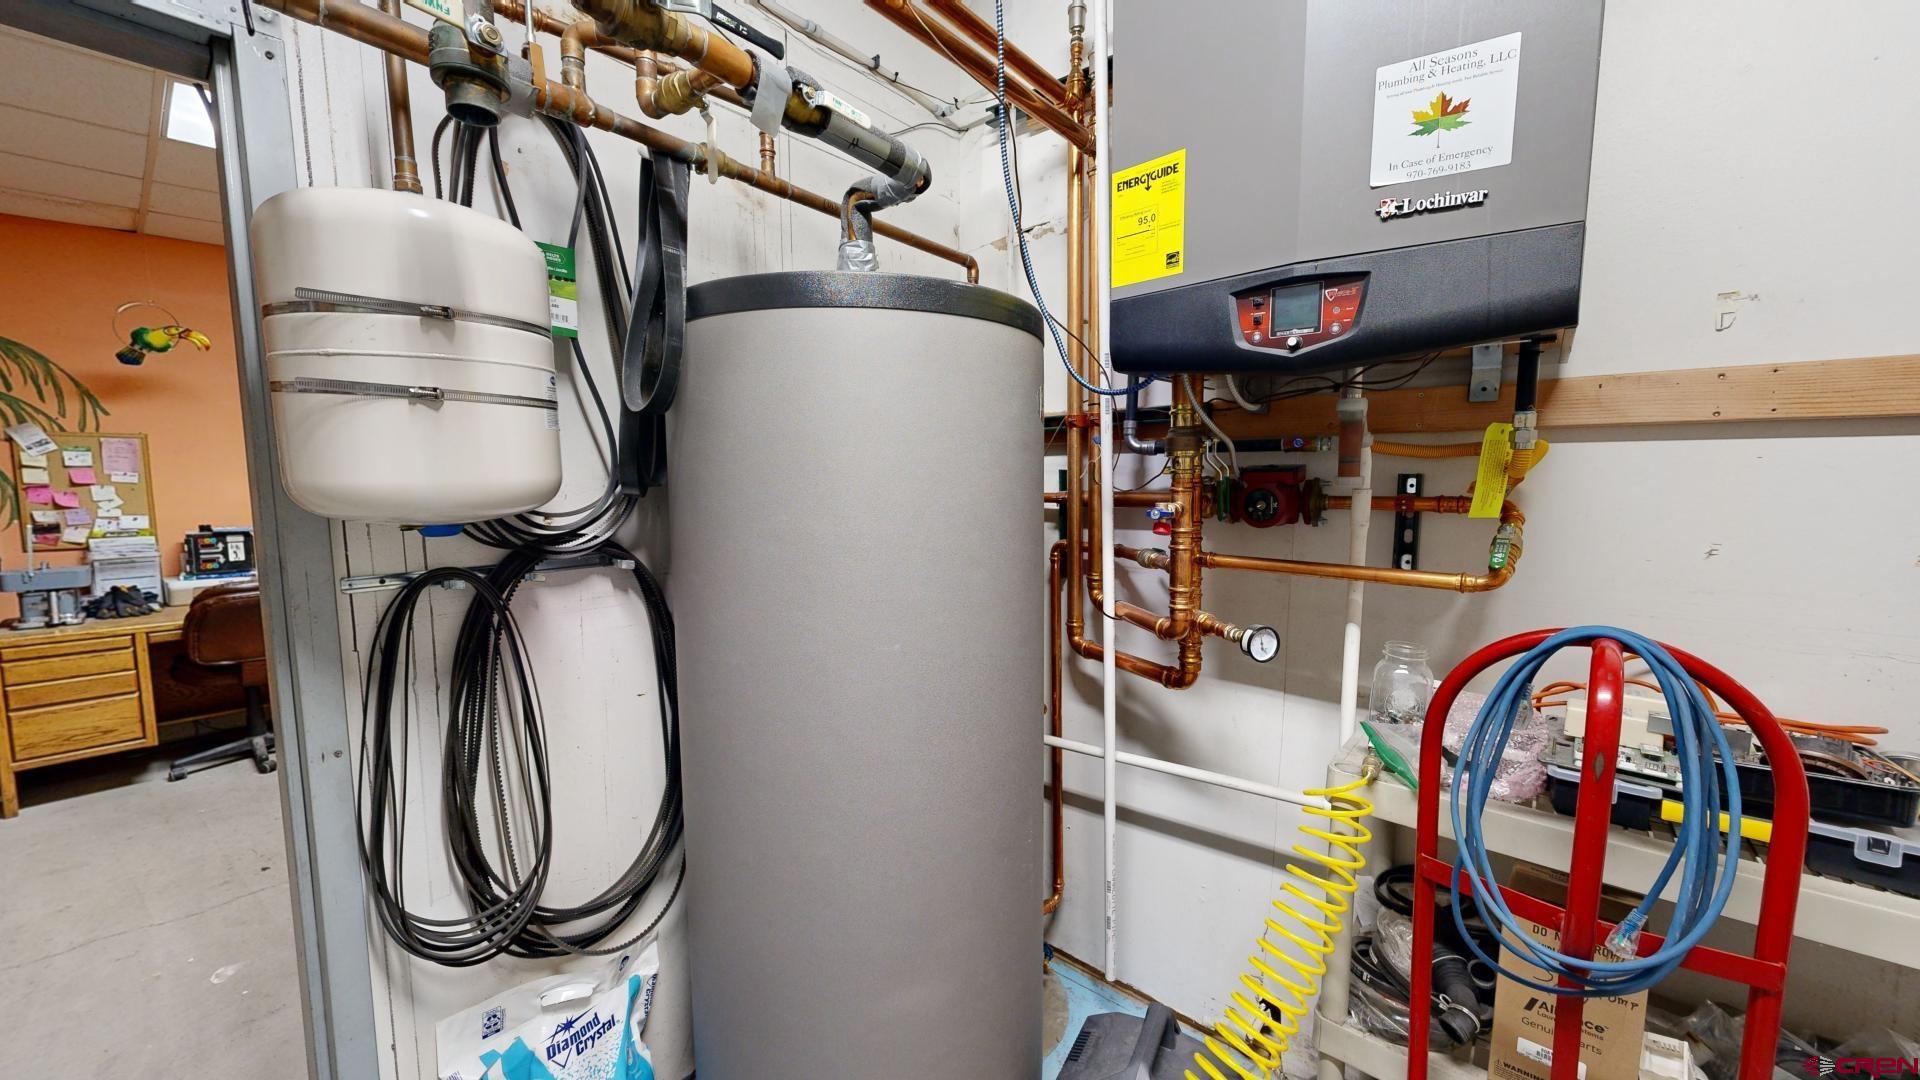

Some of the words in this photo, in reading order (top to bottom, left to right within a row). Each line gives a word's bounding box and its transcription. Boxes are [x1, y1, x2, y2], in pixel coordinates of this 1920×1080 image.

[1378, 74, 1425, 91] Plumbing
[1427, 70, 1437, 79] &
[1490, 49, 1518, 64] LLC
[1409, 59, 1426, 74] All
[1429, 49, 1479, 68] Seasons
[1388, 162, 1399, 172] In
[1401, 158, 1423, 168] Case
[1425, 154, 1438, 165] of
[1438, 145, 1494, 163] Emergency
[1406, 161, 1472, 180] 970-769-9183
[1117, 163, 1180, 192] ENERGYGUIDE
[1401, 188, 1489, 214] Lochinvar
[1137, 213, 1156, 226] 95.0
[546, 1012, 601, 1061] Diamond
[576, 1015, 617, 1056] Crystal
[1521, 1016, 1554, 1035] Genui
[1580, 1041, 1602, 1056] arts
[1503, 1061, 1547, 1080] WARNIN
